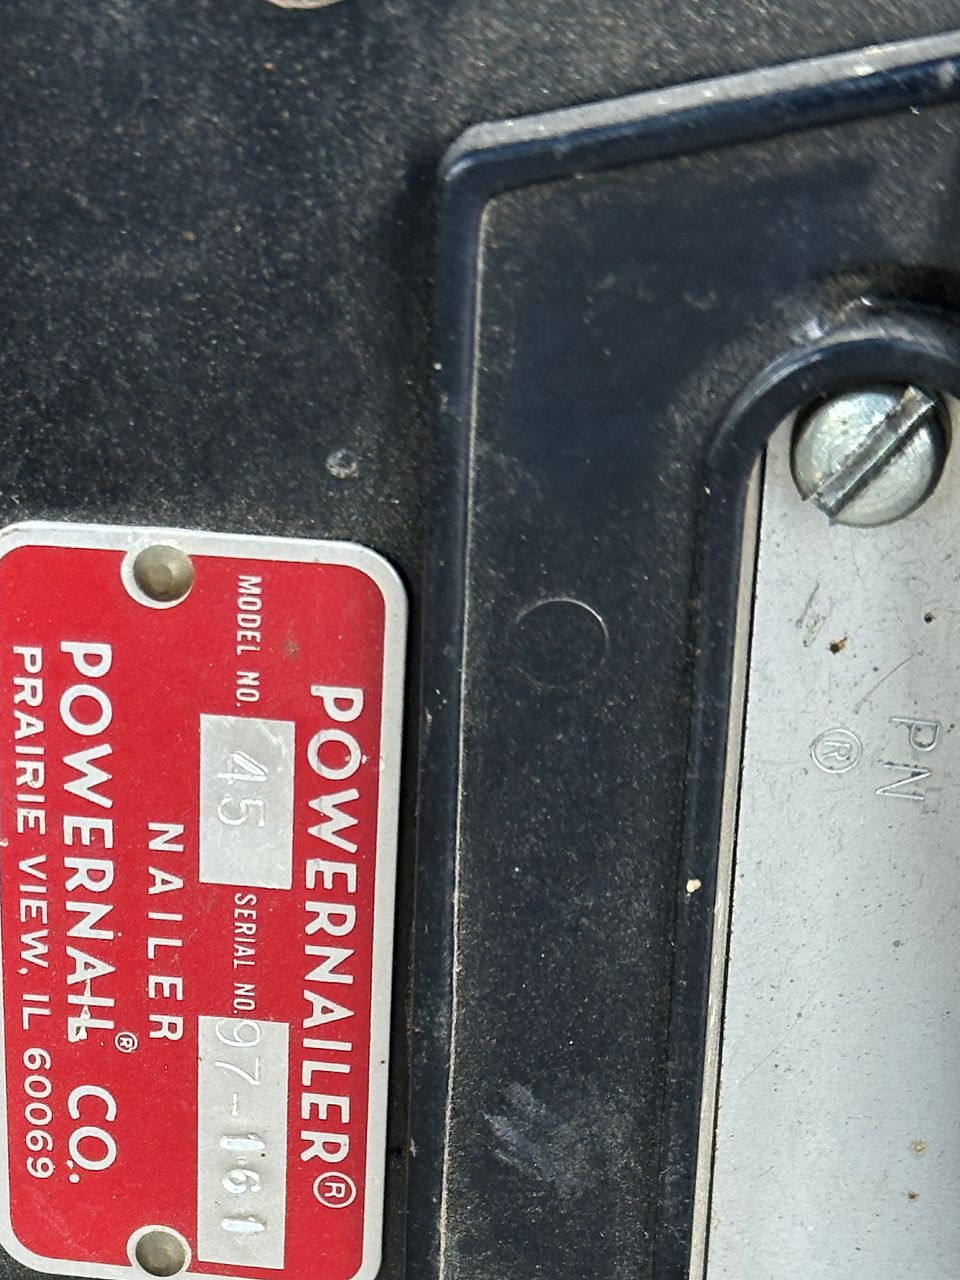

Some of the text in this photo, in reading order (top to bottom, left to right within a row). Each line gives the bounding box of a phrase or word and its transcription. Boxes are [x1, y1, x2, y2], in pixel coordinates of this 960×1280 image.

[12, 645, 55, 1180] PRAIRIE VIEW, IL 60069
[147, 821, 185, 1041] NAILER
[214, 574, 268, 1234] MODEL NO. 45 SERIAL NO. 97-161
[66, 1084, 118, 1184] CO.
